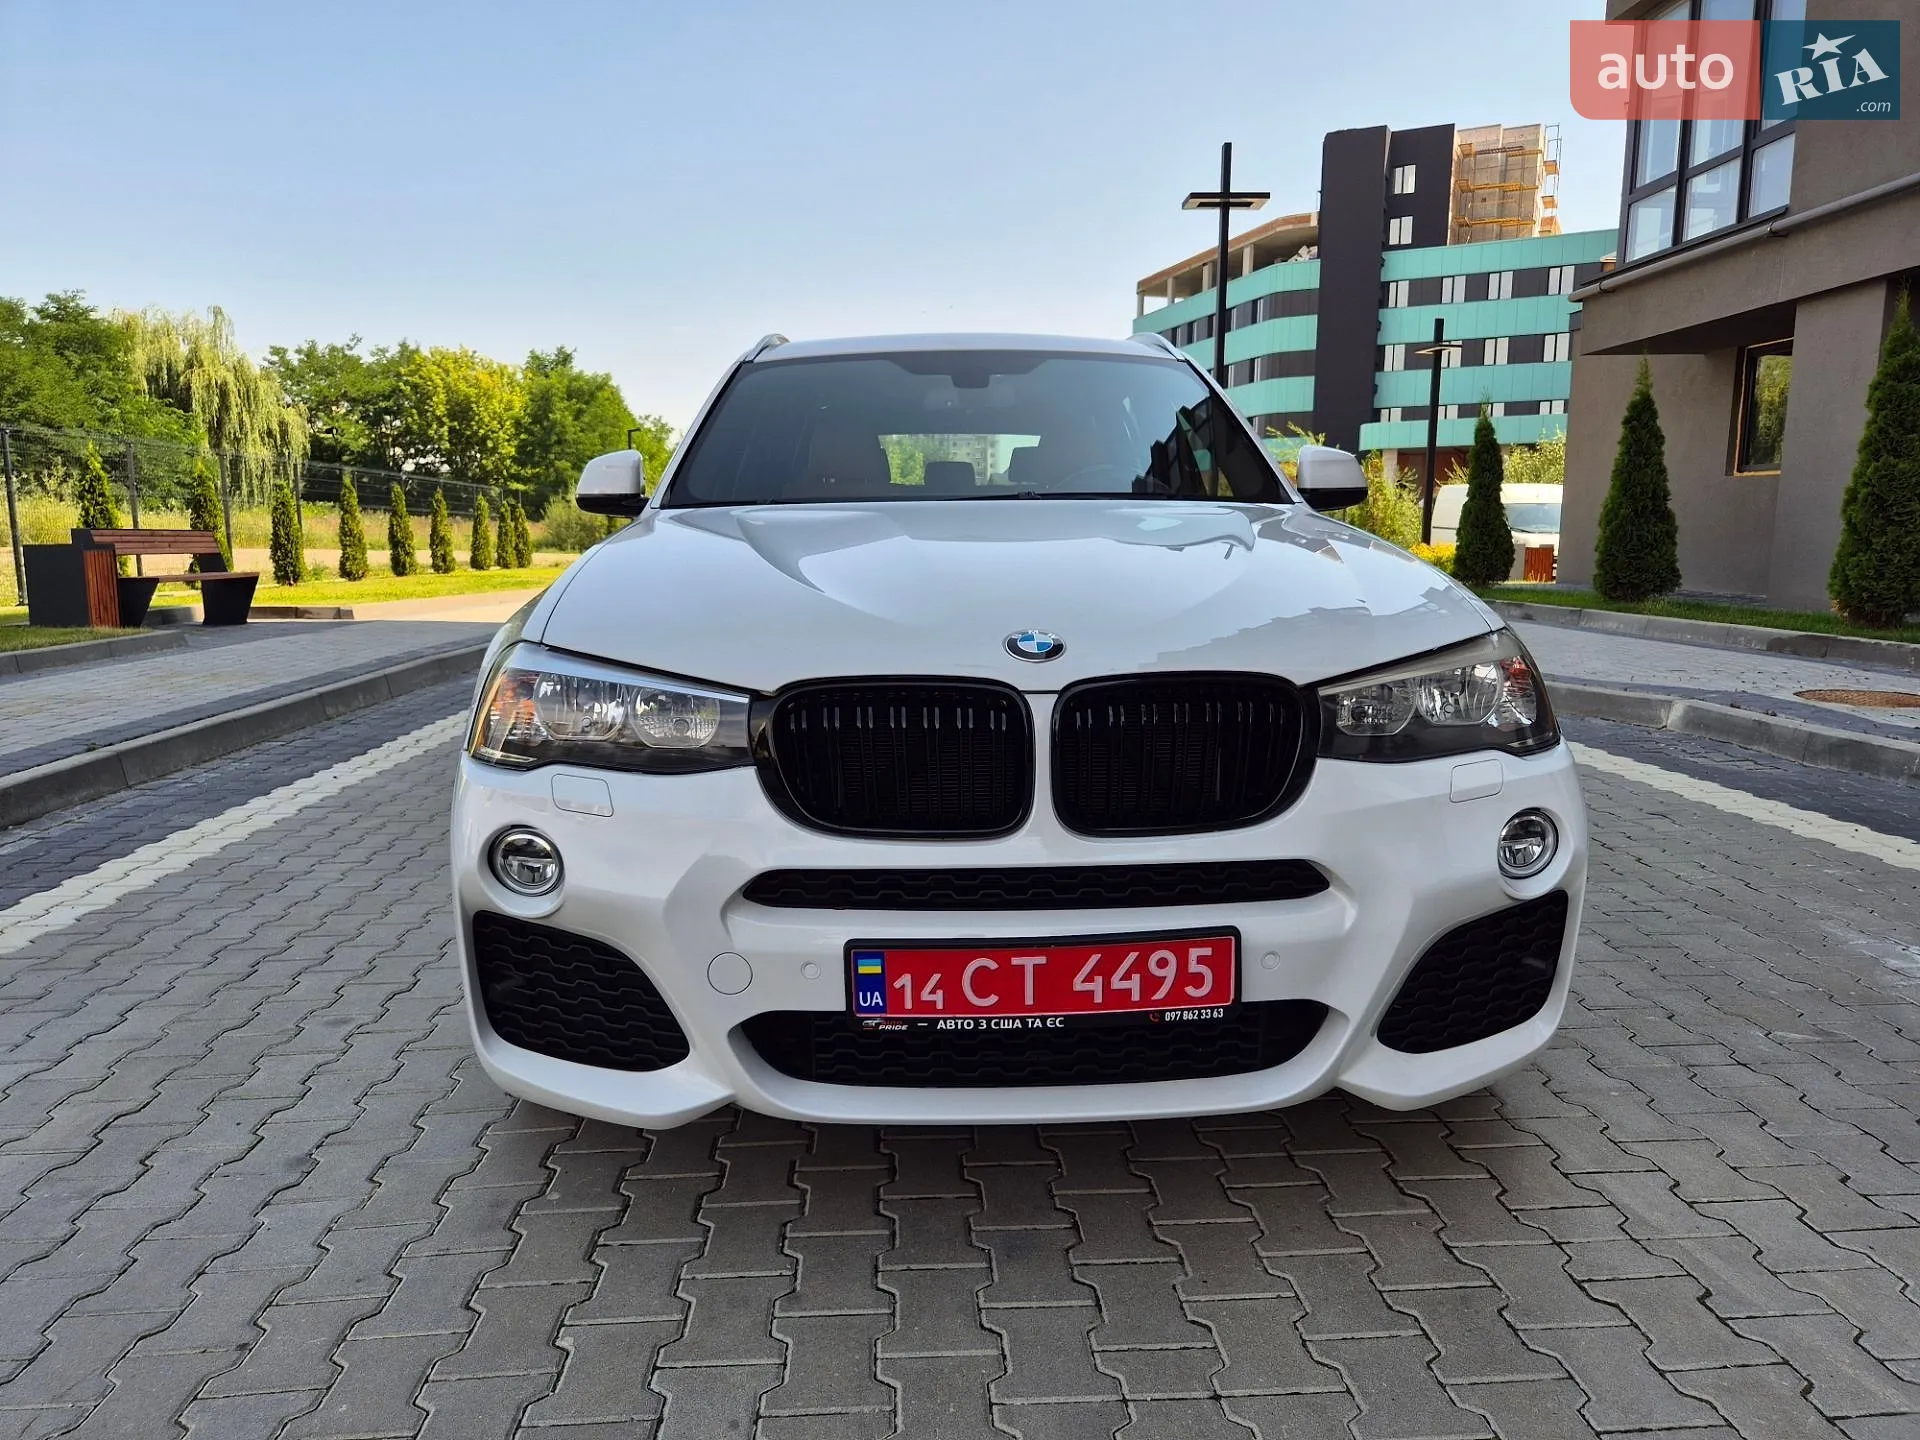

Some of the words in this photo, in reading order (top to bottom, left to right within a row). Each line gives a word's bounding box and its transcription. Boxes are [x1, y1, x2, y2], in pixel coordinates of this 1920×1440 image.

[893, 973, 944, 1010] 14
[1072, 947, 1213, 1003] 4495
[859, 991, 883, 1007] UA
[1164, 1011, 1181, 1021] 097
[1182, 1009, 1199, 1020] 862
[1200, 1009, 1211, 1019] 33
[1212, 1007, 1224, 1018] 63
[936, 1019, 975, 1030] АВТО
[990, 1019, 1022, 1029] США
[1026, 1018, 1043, 1029] ТА
[1046, 1017, 1065, 1028] ЄС
